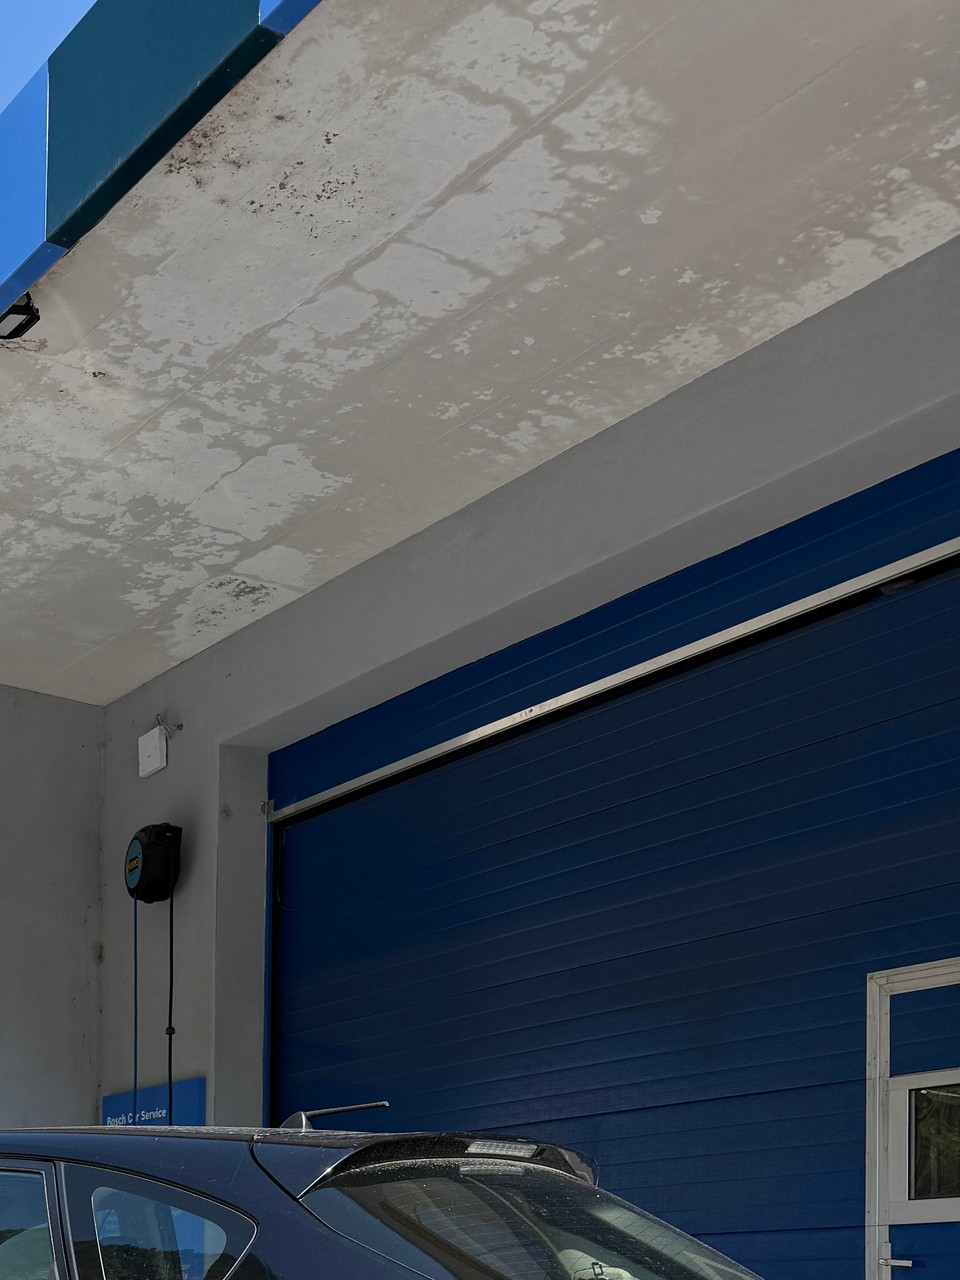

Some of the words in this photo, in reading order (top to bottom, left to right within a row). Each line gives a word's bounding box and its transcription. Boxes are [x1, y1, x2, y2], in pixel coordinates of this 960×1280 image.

[107, 1114, 126, 1126] Bosch
[128, 1113, 140, 1123] Cr
[141, 1108, 166, 1120] Service
